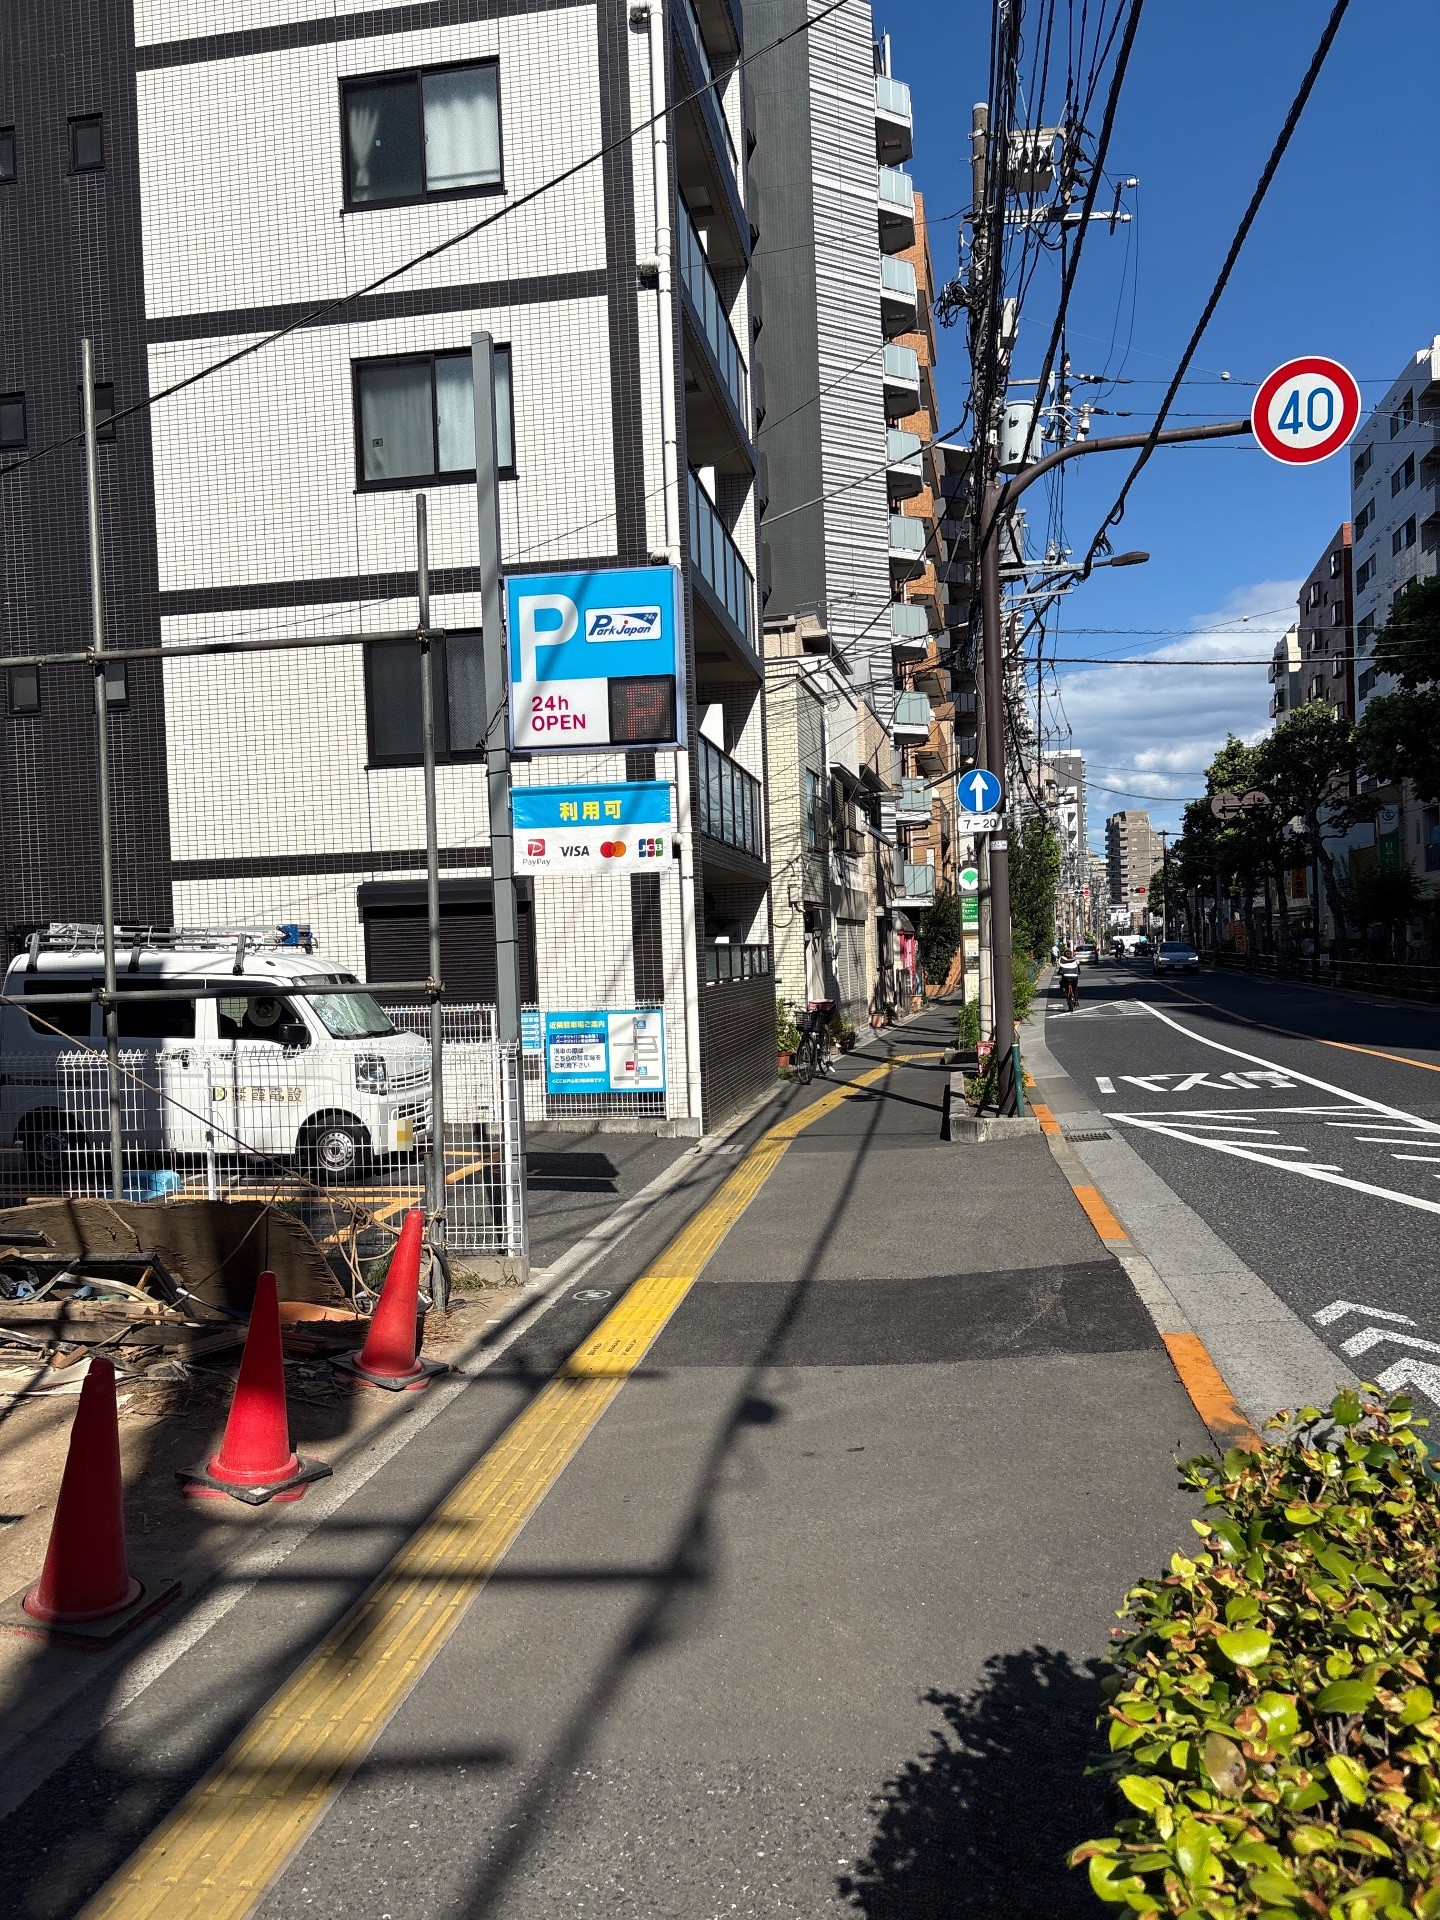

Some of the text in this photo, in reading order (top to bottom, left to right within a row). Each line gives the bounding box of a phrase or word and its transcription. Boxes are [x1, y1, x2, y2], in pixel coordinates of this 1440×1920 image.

[1278, 387, 1334, 435] 40
[518, 593, 579, 683] P
[531, 695, 569, 712] 24h
[531, 713, 586, 732] OPEN
[559, 799, 622, 822] 利用可
[560, 845, 590, 857] VISA
[522, 858, 551, 866] PayPay
